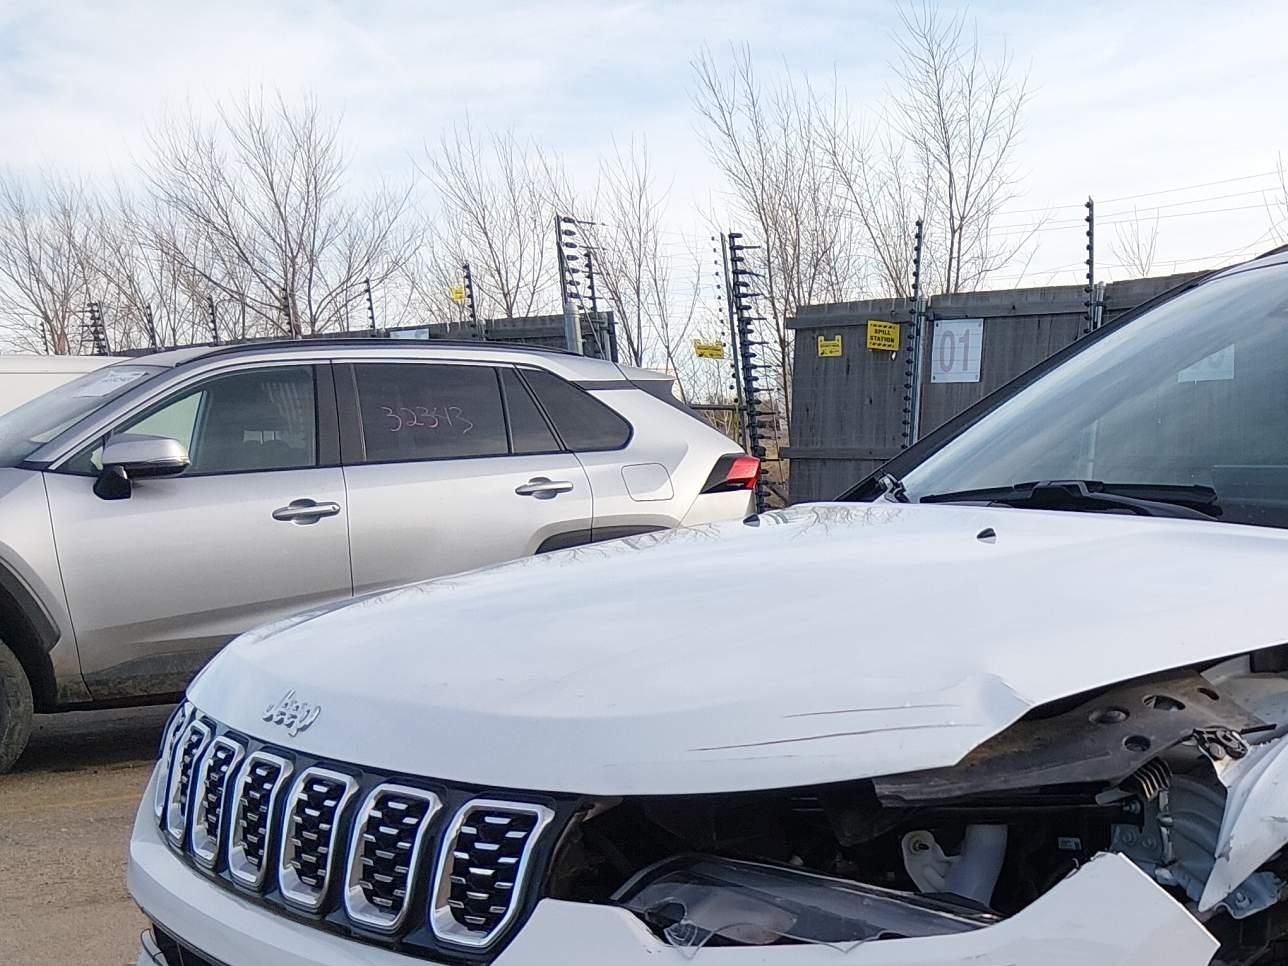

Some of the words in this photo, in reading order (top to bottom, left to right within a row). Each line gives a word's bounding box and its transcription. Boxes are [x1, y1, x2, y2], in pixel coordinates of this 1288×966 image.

[869, 335, 895, 343] STATION
[874, 328, 892, 336] SPILL
[939, 328, 970, 373] 01
[262, 688, 321, 738] Jeep
